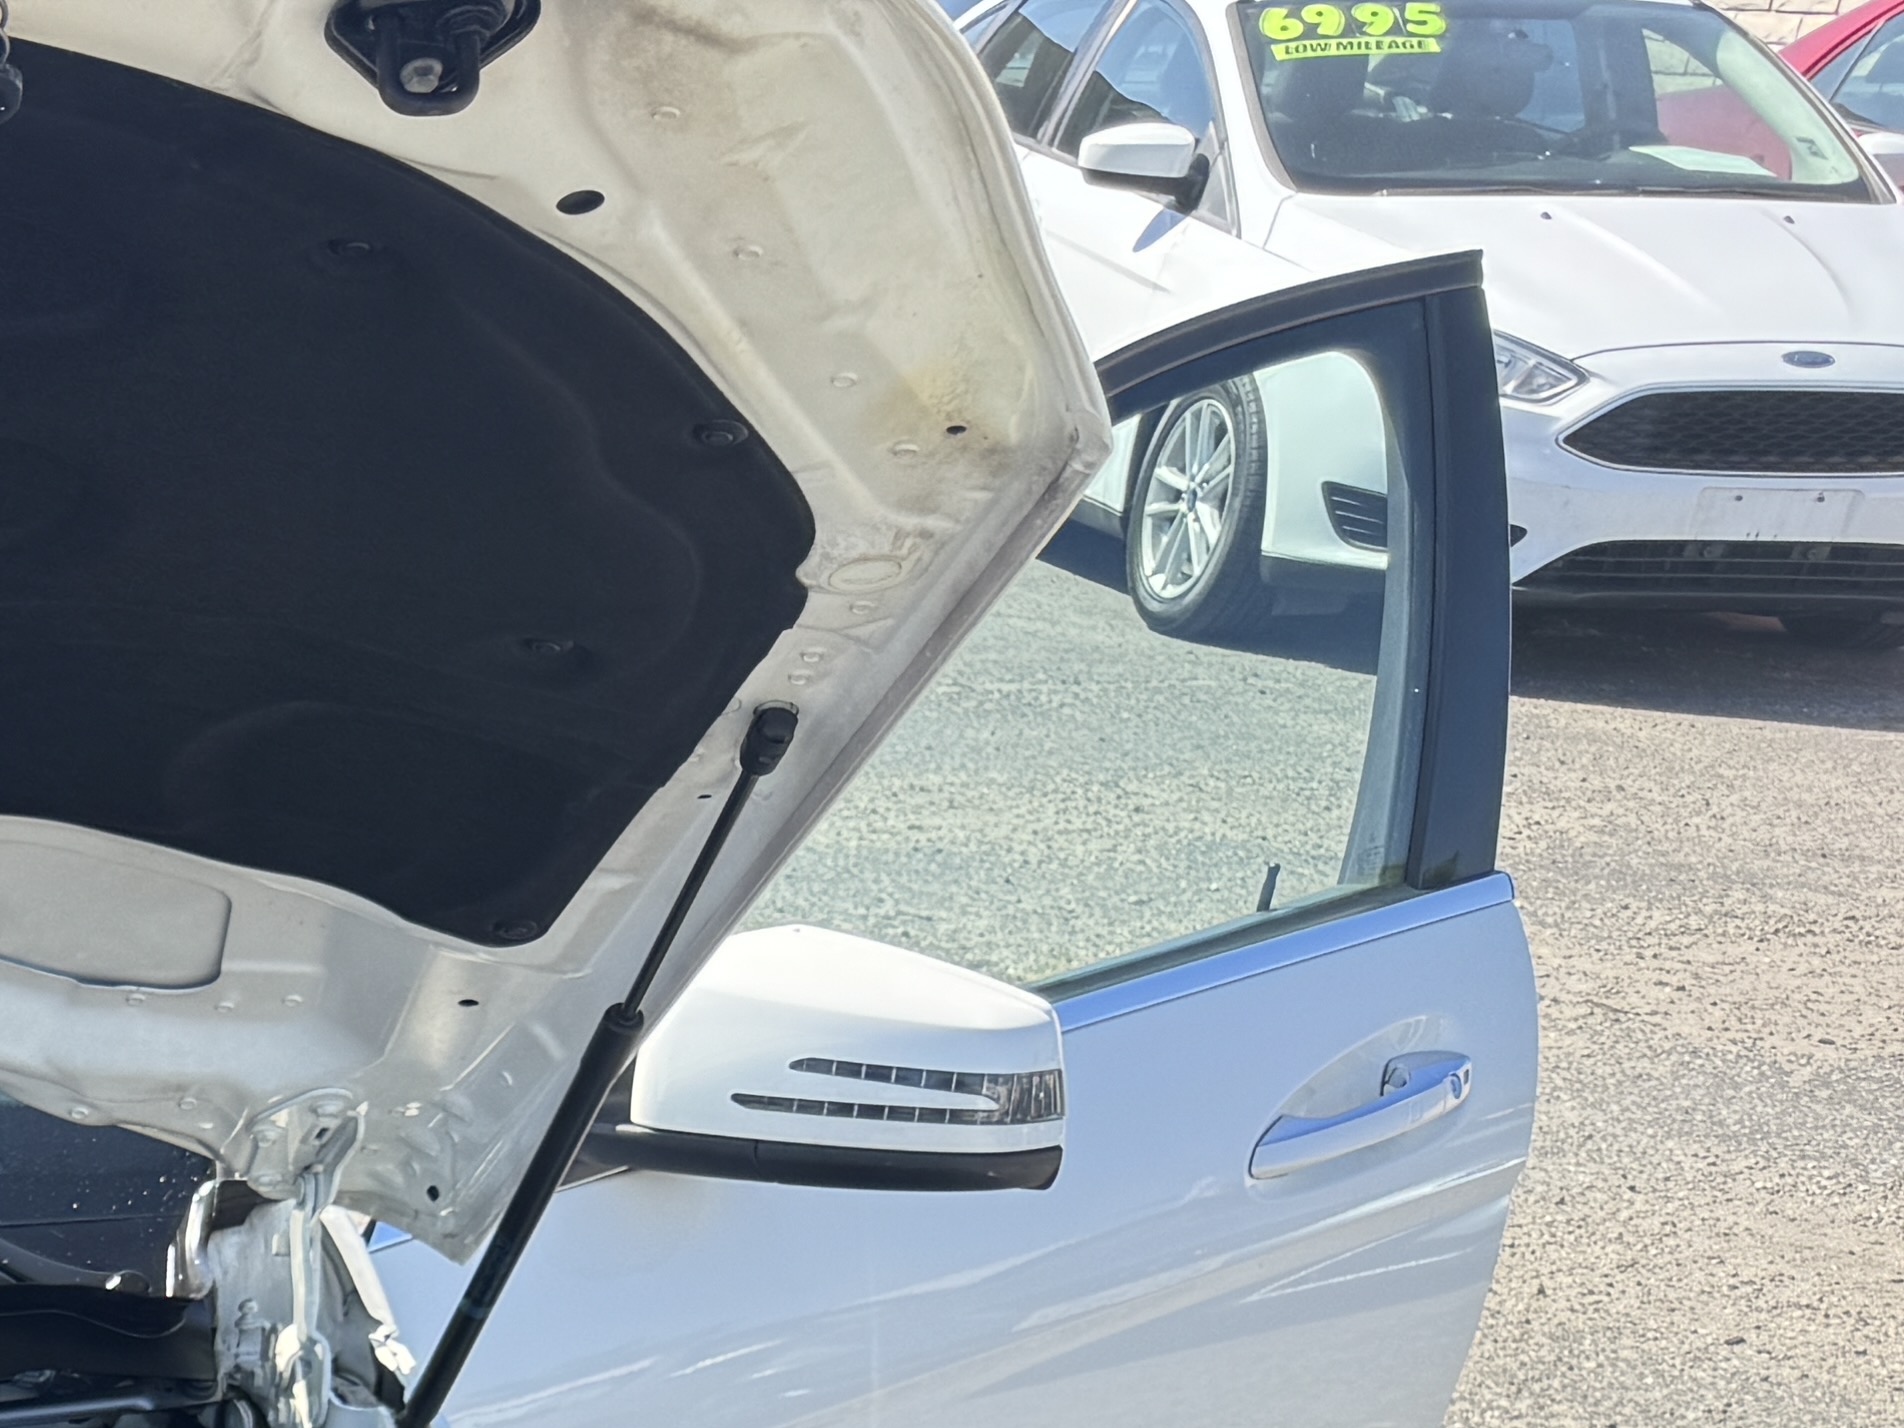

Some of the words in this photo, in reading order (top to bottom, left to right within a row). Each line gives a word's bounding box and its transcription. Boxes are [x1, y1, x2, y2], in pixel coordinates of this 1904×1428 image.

[1259, 2, 1446, 40] 6995
[1285, 42, 1330, 55] LOW
[1336, 40, 1425, 51] MILEAGE
